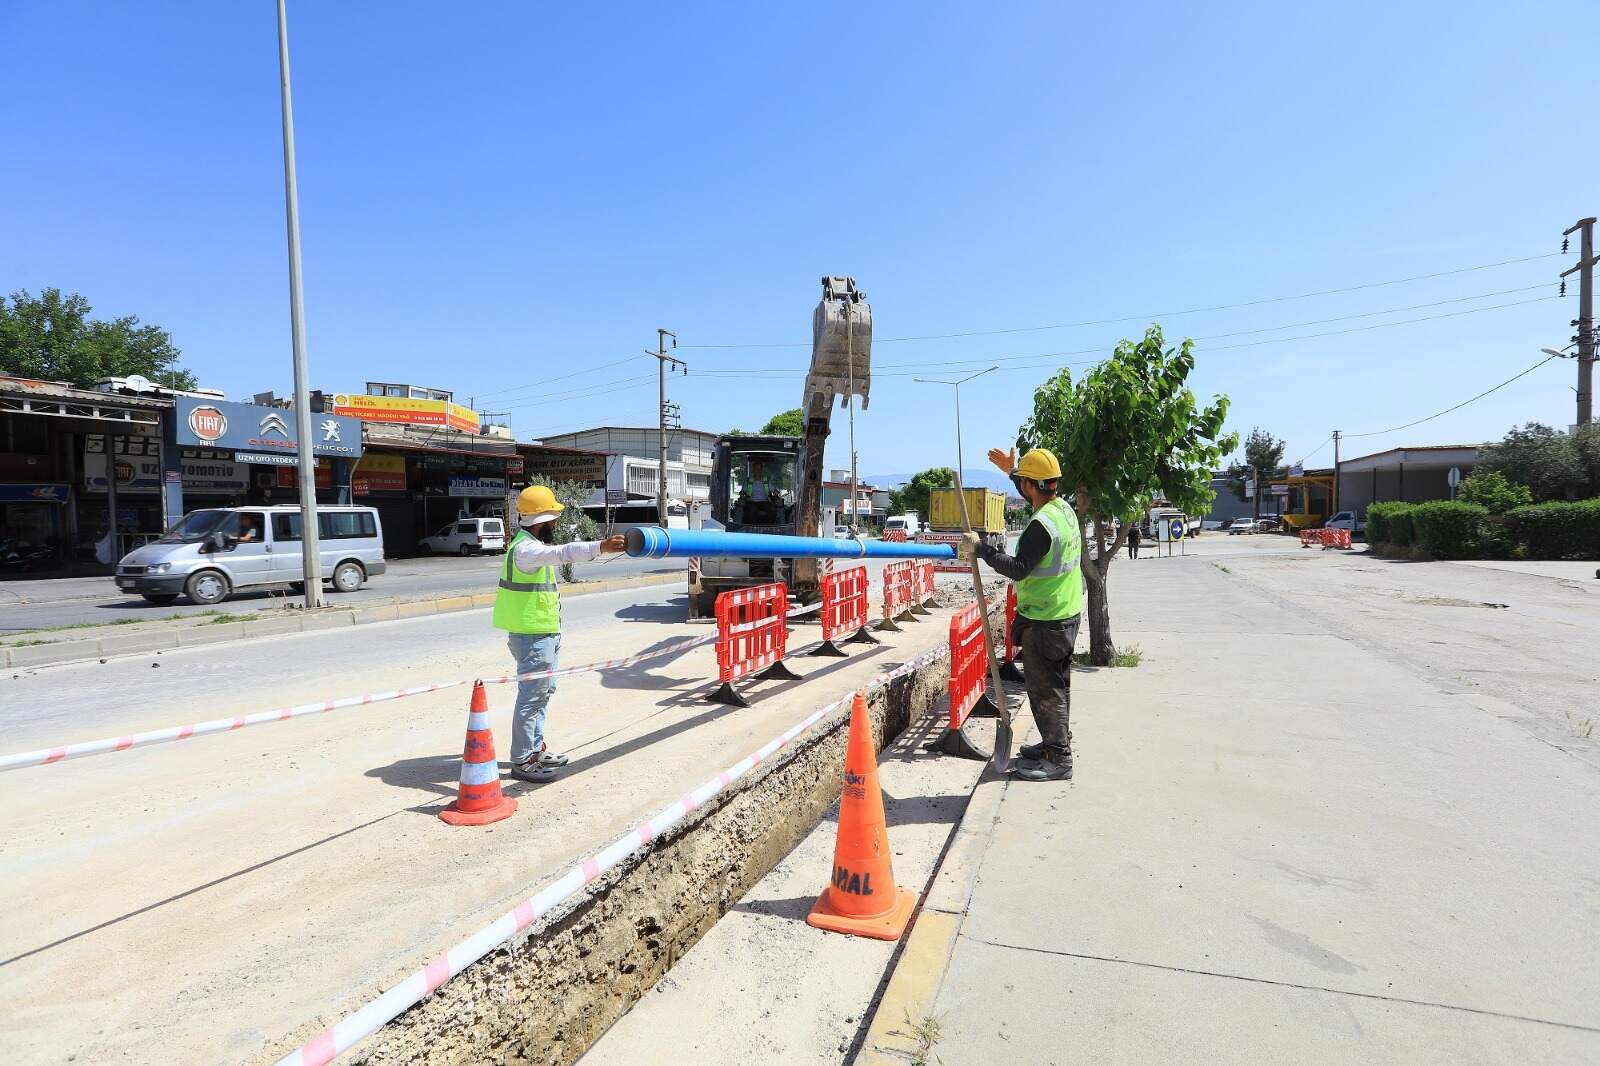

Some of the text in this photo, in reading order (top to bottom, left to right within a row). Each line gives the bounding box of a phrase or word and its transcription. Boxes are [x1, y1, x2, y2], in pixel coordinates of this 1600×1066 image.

[198, 415, 219, 432] FIAT
[199, 439, 216, 447] FIAT
[238, 455, 254, 463] UZN
[271, 457, 293, 465] YEDEK
[142, 463, 159, 475] UZ
[181, 463, 234, 477] TOMOTİV
